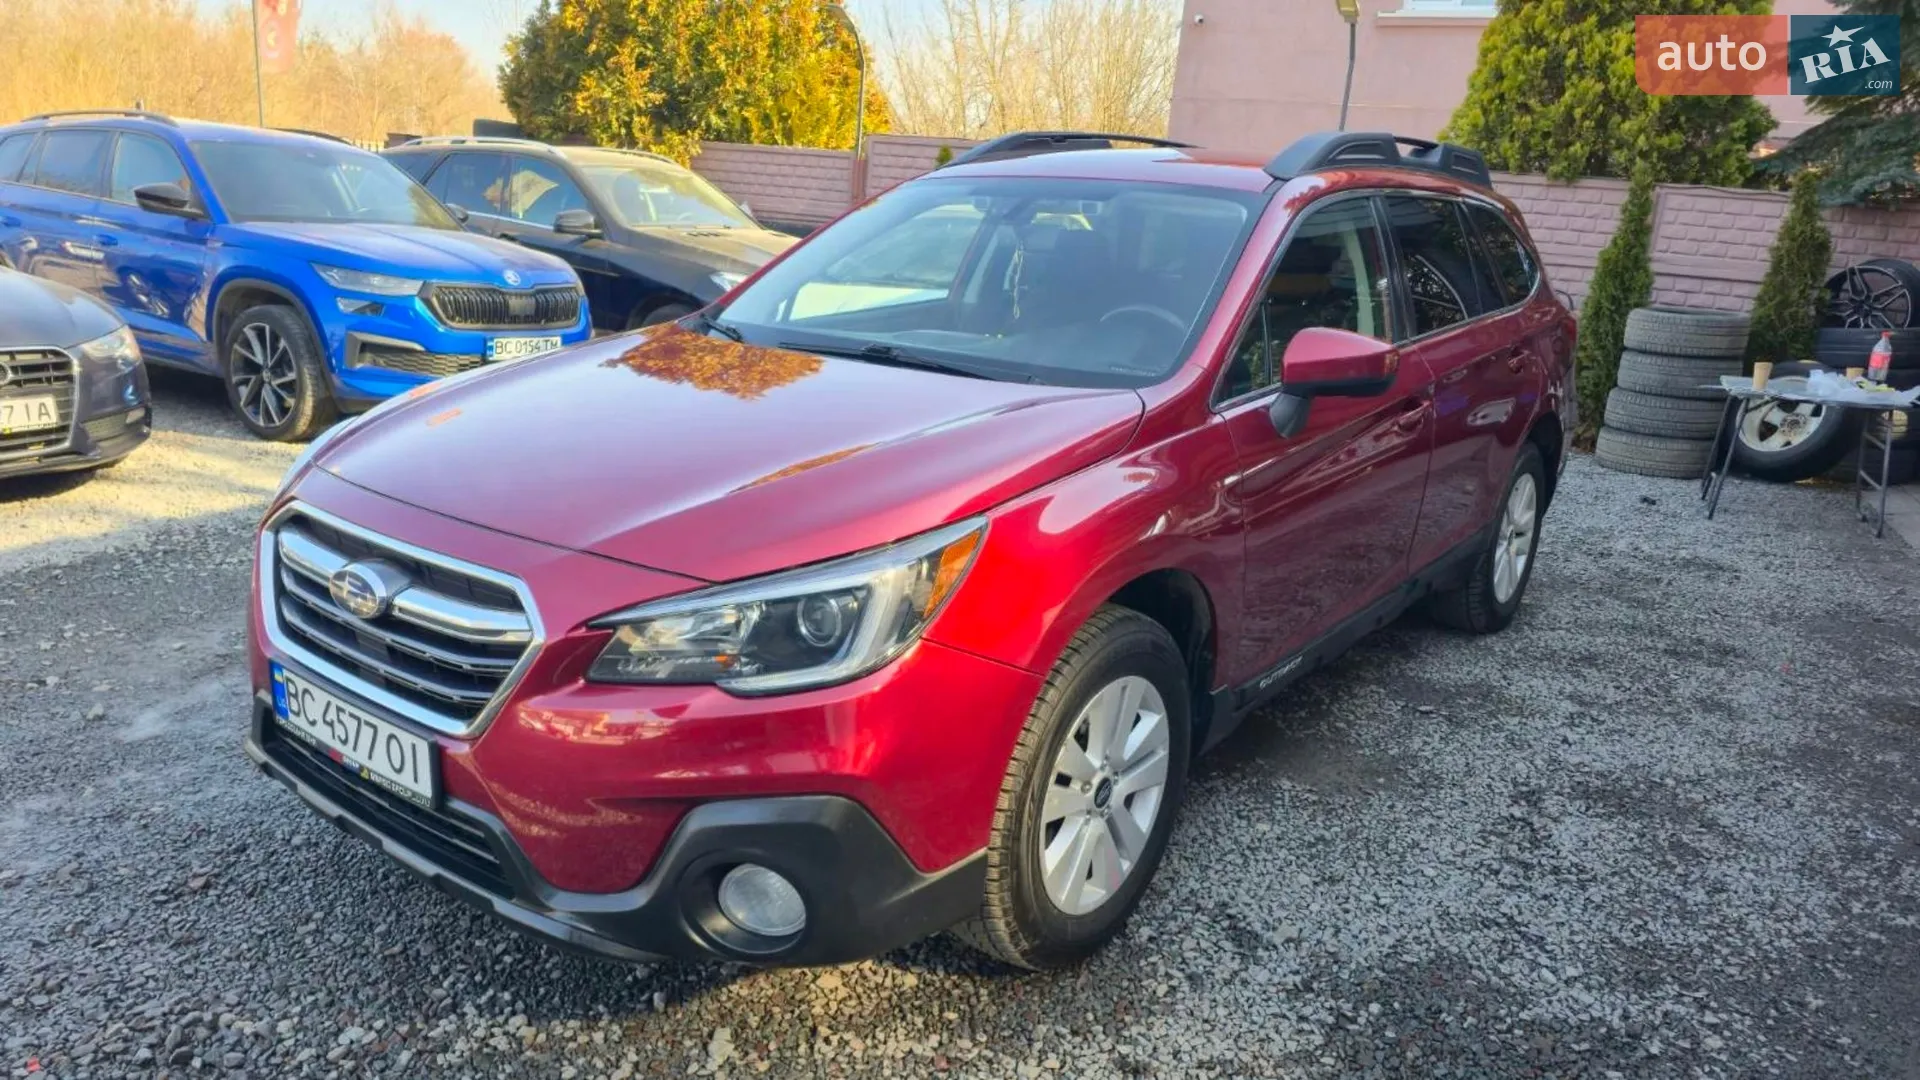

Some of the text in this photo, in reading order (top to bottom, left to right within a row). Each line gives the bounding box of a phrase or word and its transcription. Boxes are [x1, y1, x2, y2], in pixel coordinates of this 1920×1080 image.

[495, 341, 513, 355] BC
[515, 339, 541, 354] 0154
[25, 402, 52, 421] IA
[285, 676, 317, 727] BC
[322, 700, 379, 761] 4577
[386, 733, 419, 784] OI
